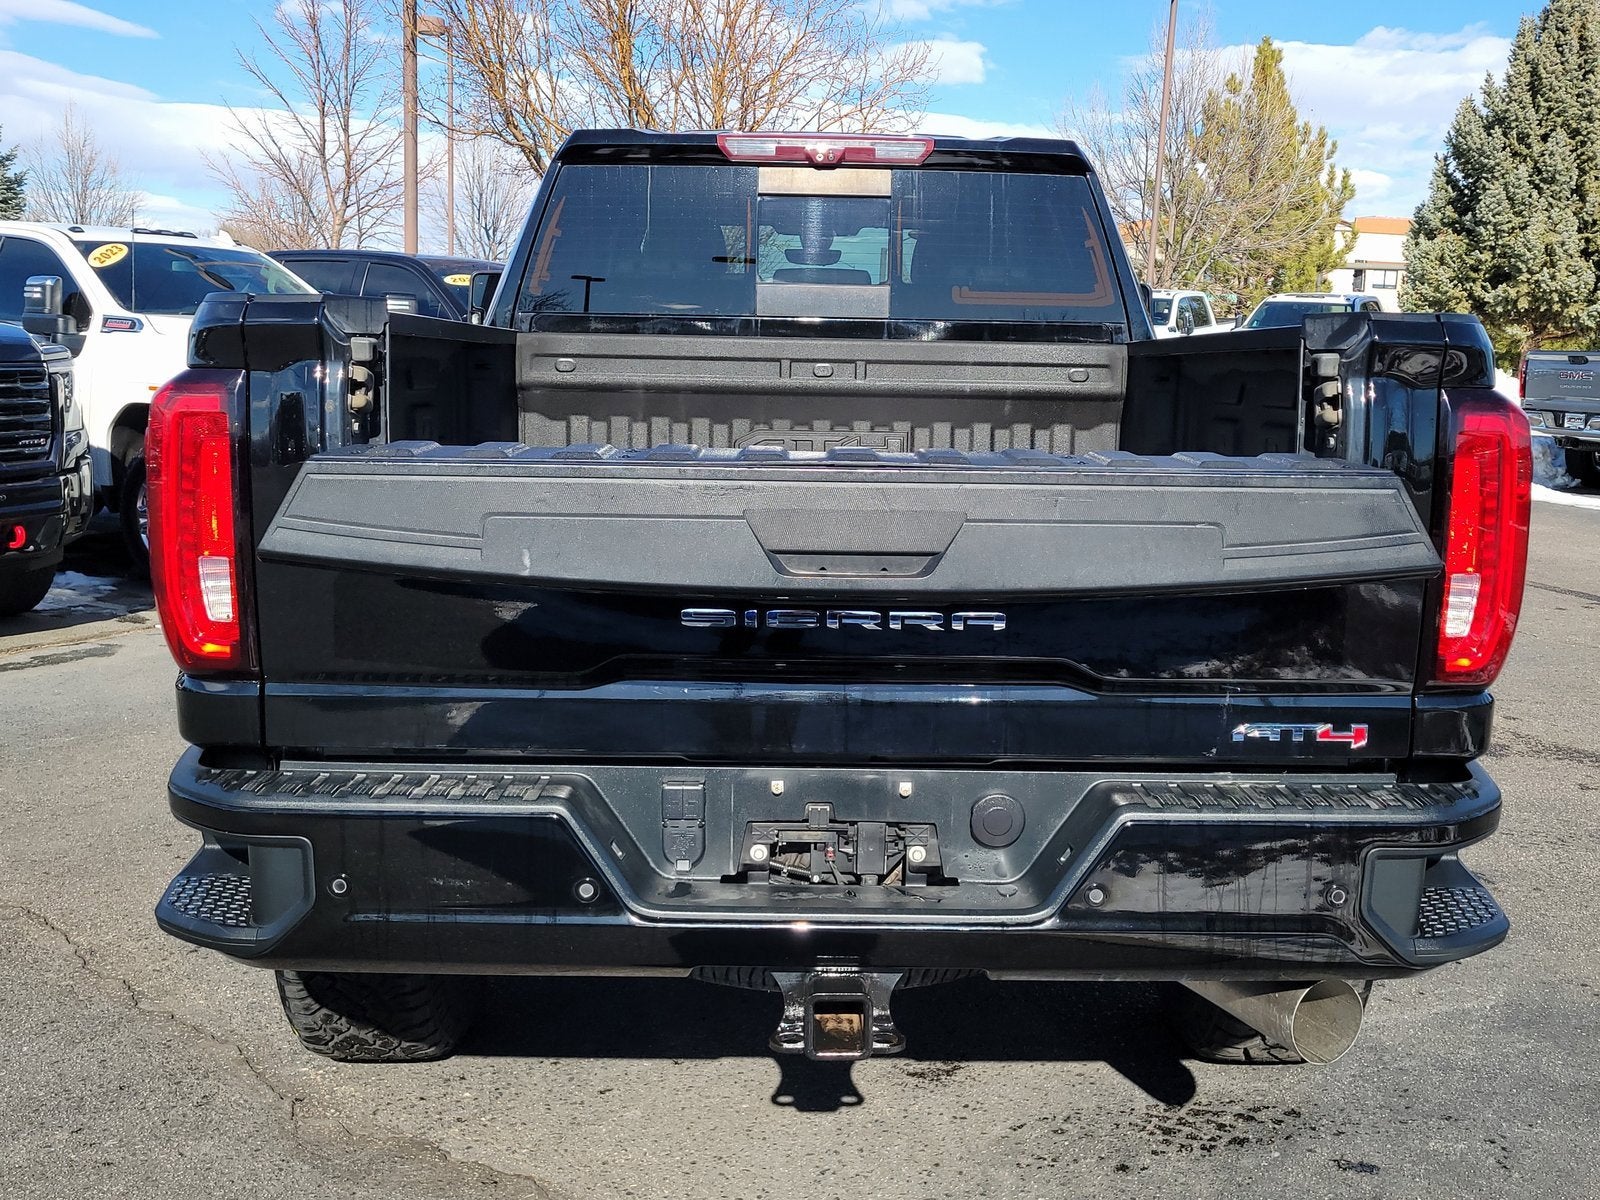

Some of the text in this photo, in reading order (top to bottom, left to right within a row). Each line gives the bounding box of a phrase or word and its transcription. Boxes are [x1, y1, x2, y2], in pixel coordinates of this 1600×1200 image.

[93, 245, 124, 264] 2023
[1559, 370, 1593, 381] GMC
[680, 608, 1007, 631] SIERRA
[1231, 722, 1369, 749] AT4
